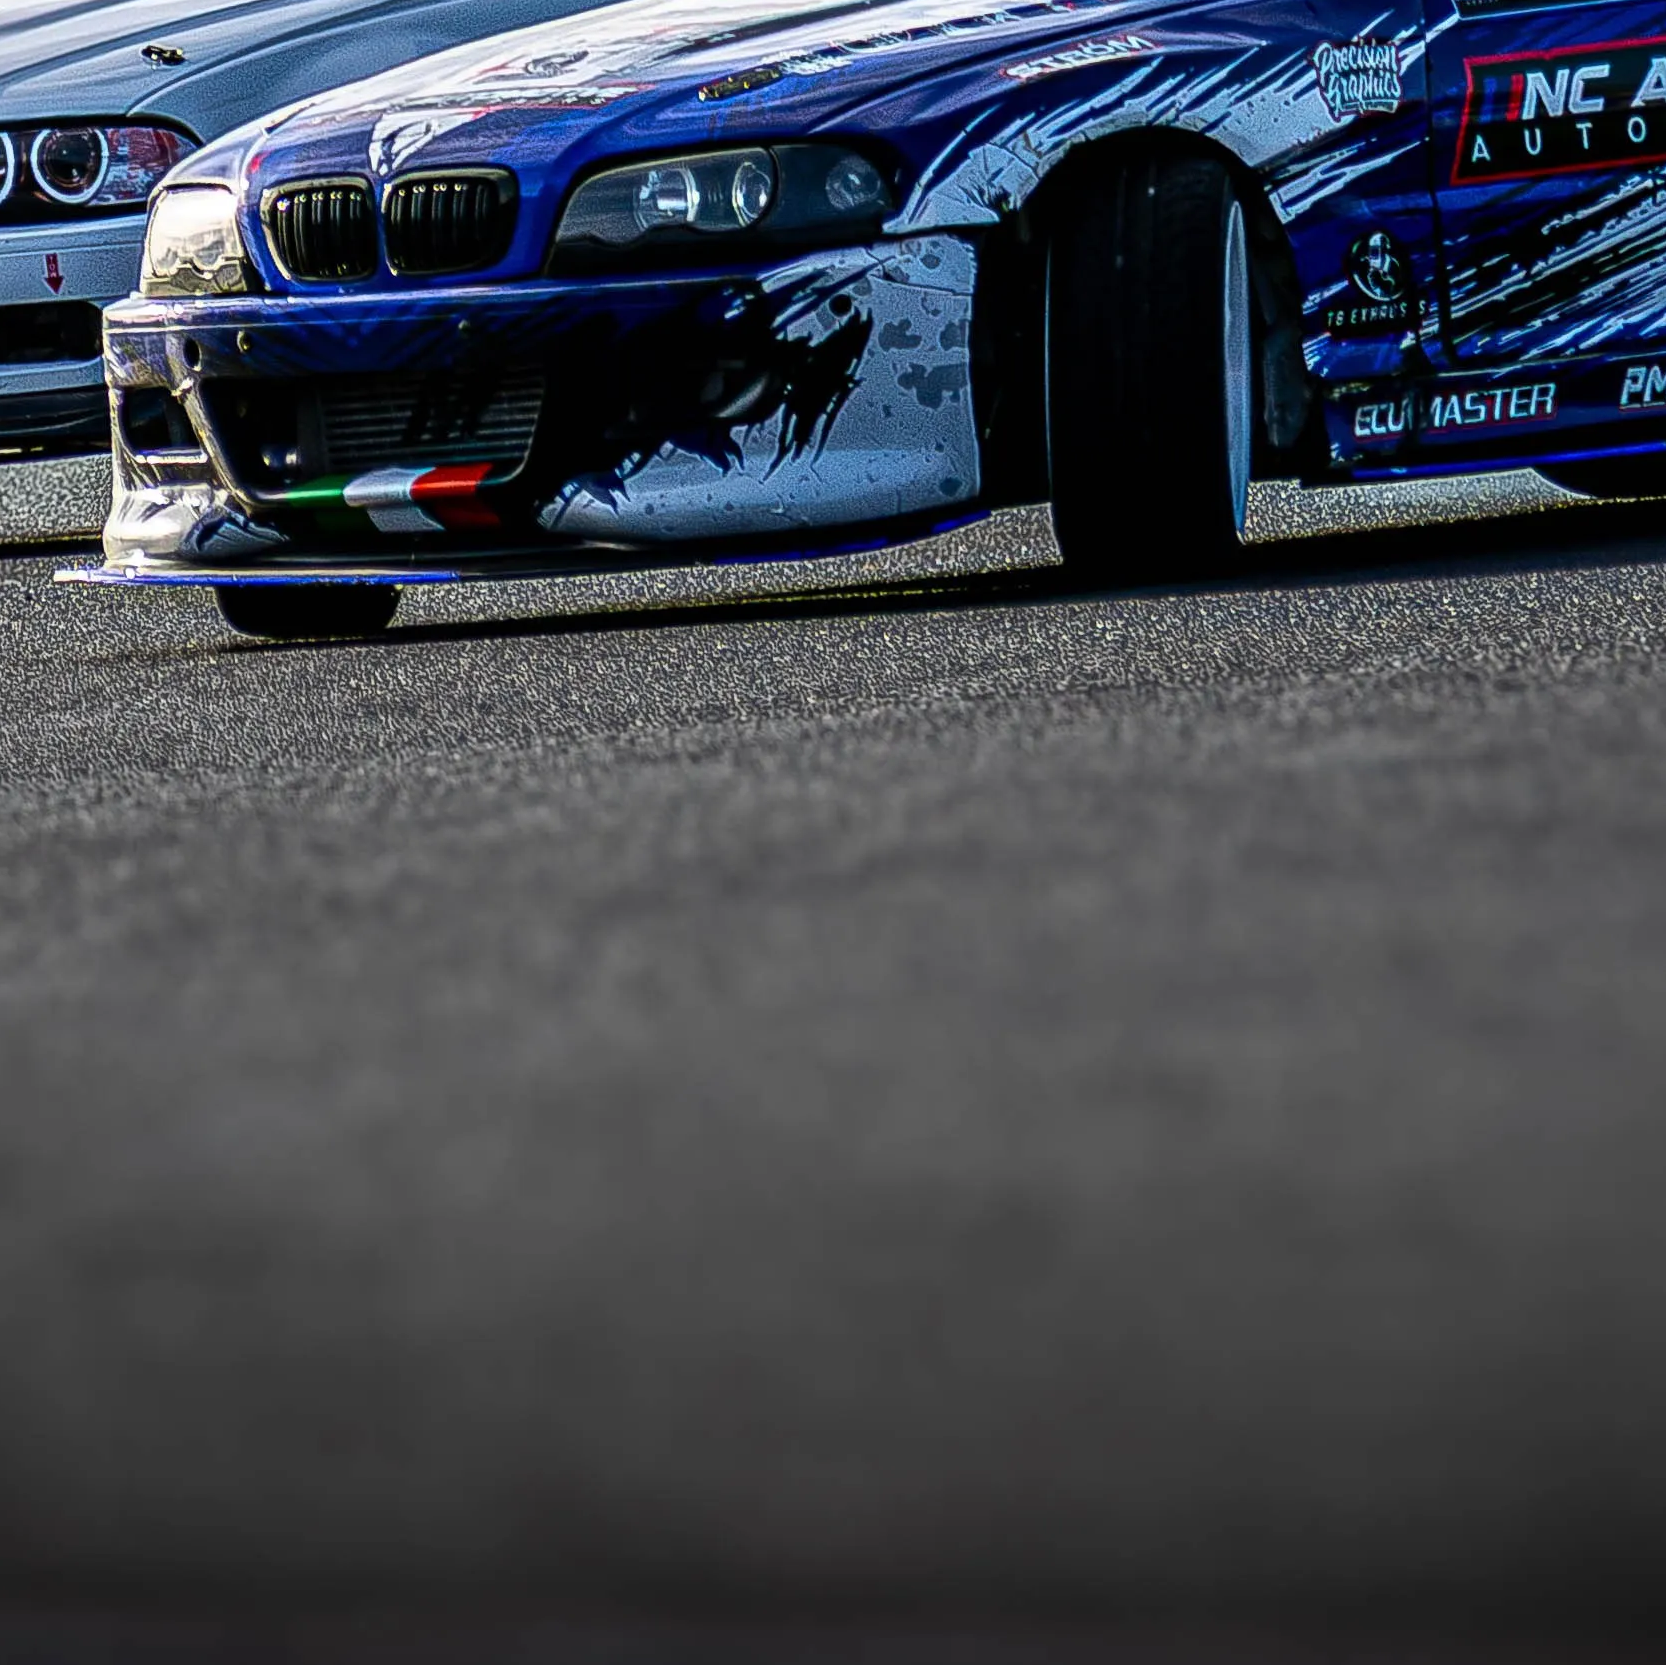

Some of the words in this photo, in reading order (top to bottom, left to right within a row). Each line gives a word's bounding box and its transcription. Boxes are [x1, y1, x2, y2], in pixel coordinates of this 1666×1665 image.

[1315, 39, 1398, 89] Precision
[1521, 64, 1611, 122] NC
[1470, 116, 1647, 164] AUTO
[1350, 299, 1426, 325] EXHAUSS
